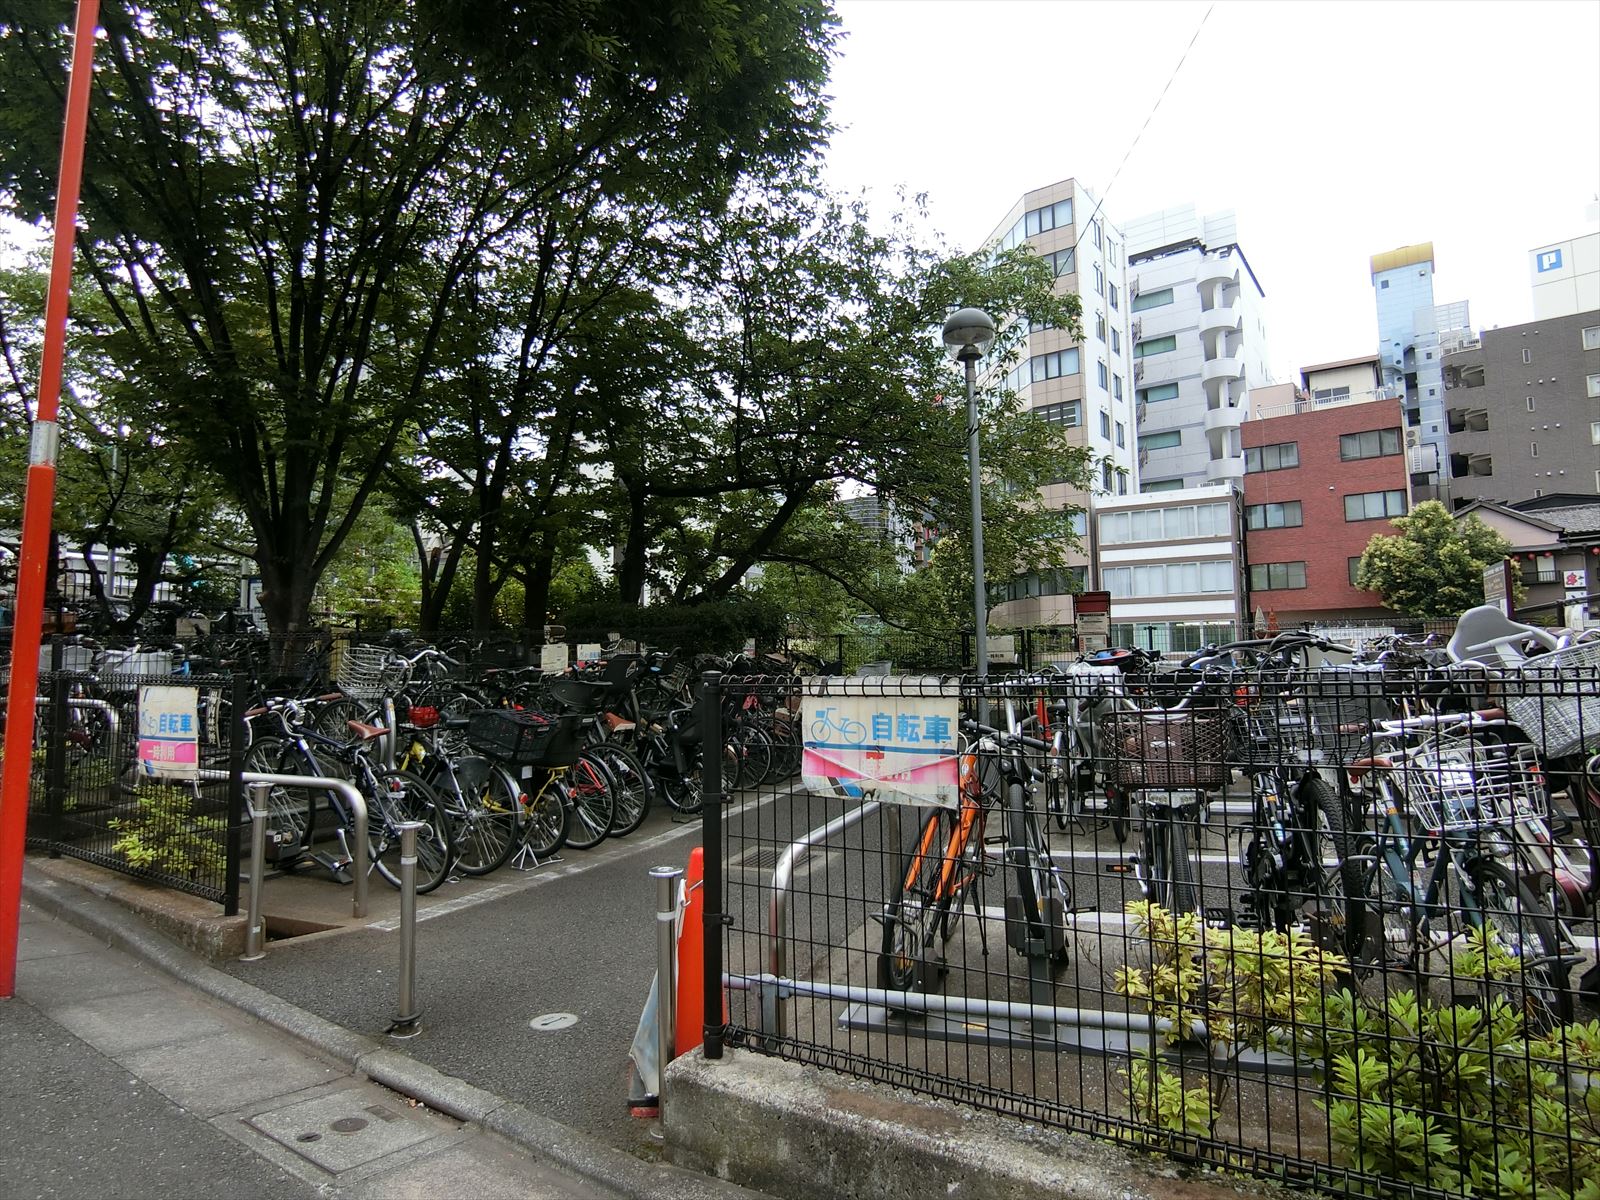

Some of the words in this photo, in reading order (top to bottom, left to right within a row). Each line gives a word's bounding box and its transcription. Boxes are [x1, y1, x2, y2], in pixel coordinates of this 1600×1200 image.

[1542, 252, 1557, 270] P
[159, 713, 193, 734] 自転車
[871, 712, 952, 744] 自転車
